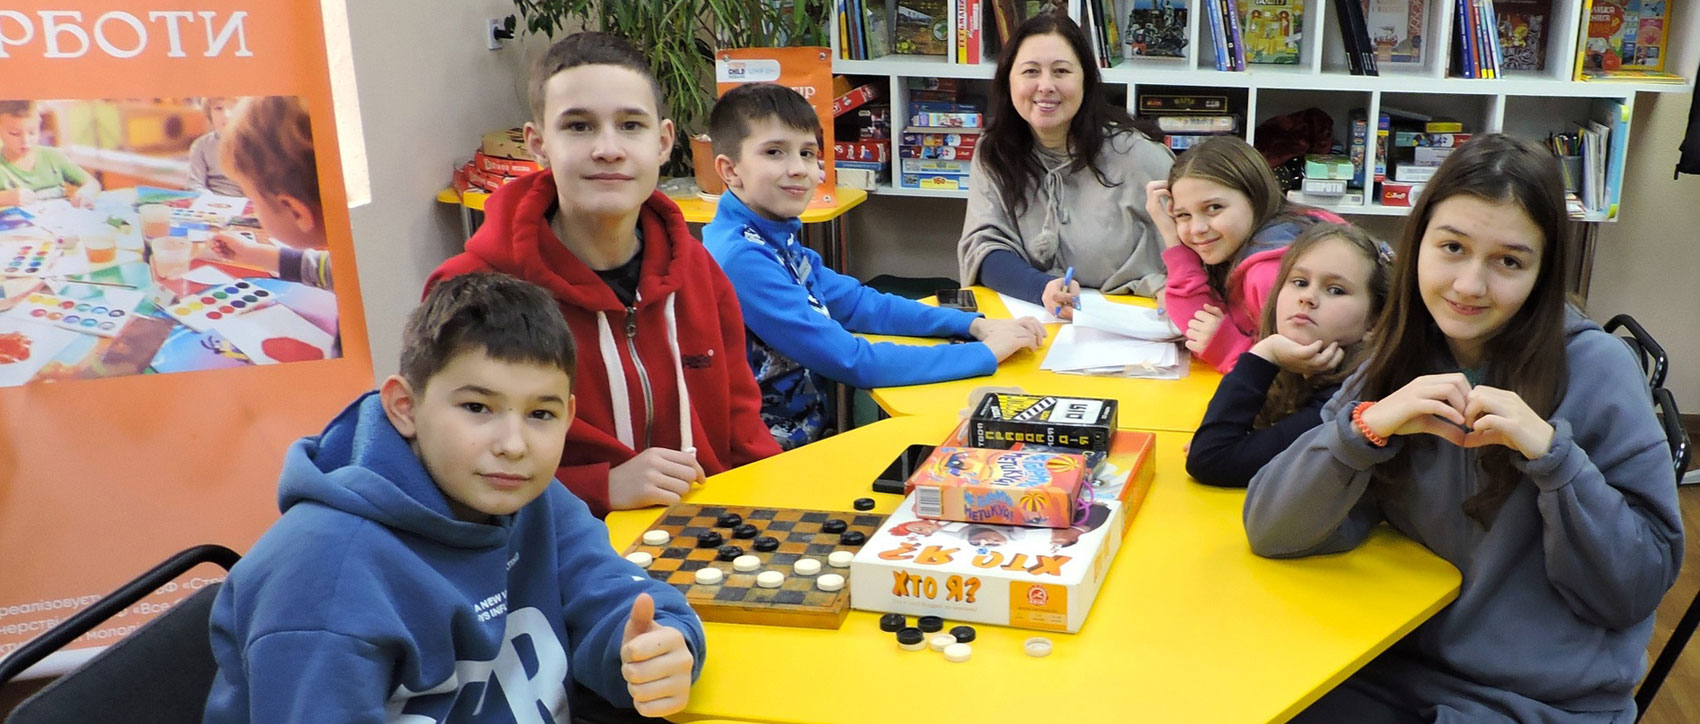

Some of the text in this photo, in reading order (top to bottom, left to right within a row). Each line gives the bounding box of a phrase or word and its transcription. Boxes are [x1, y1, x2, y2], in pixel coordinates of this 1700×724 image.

[977, 422, 985, 447] ТВОЯ
[892, 570, 982, 604] ХТО Я?
